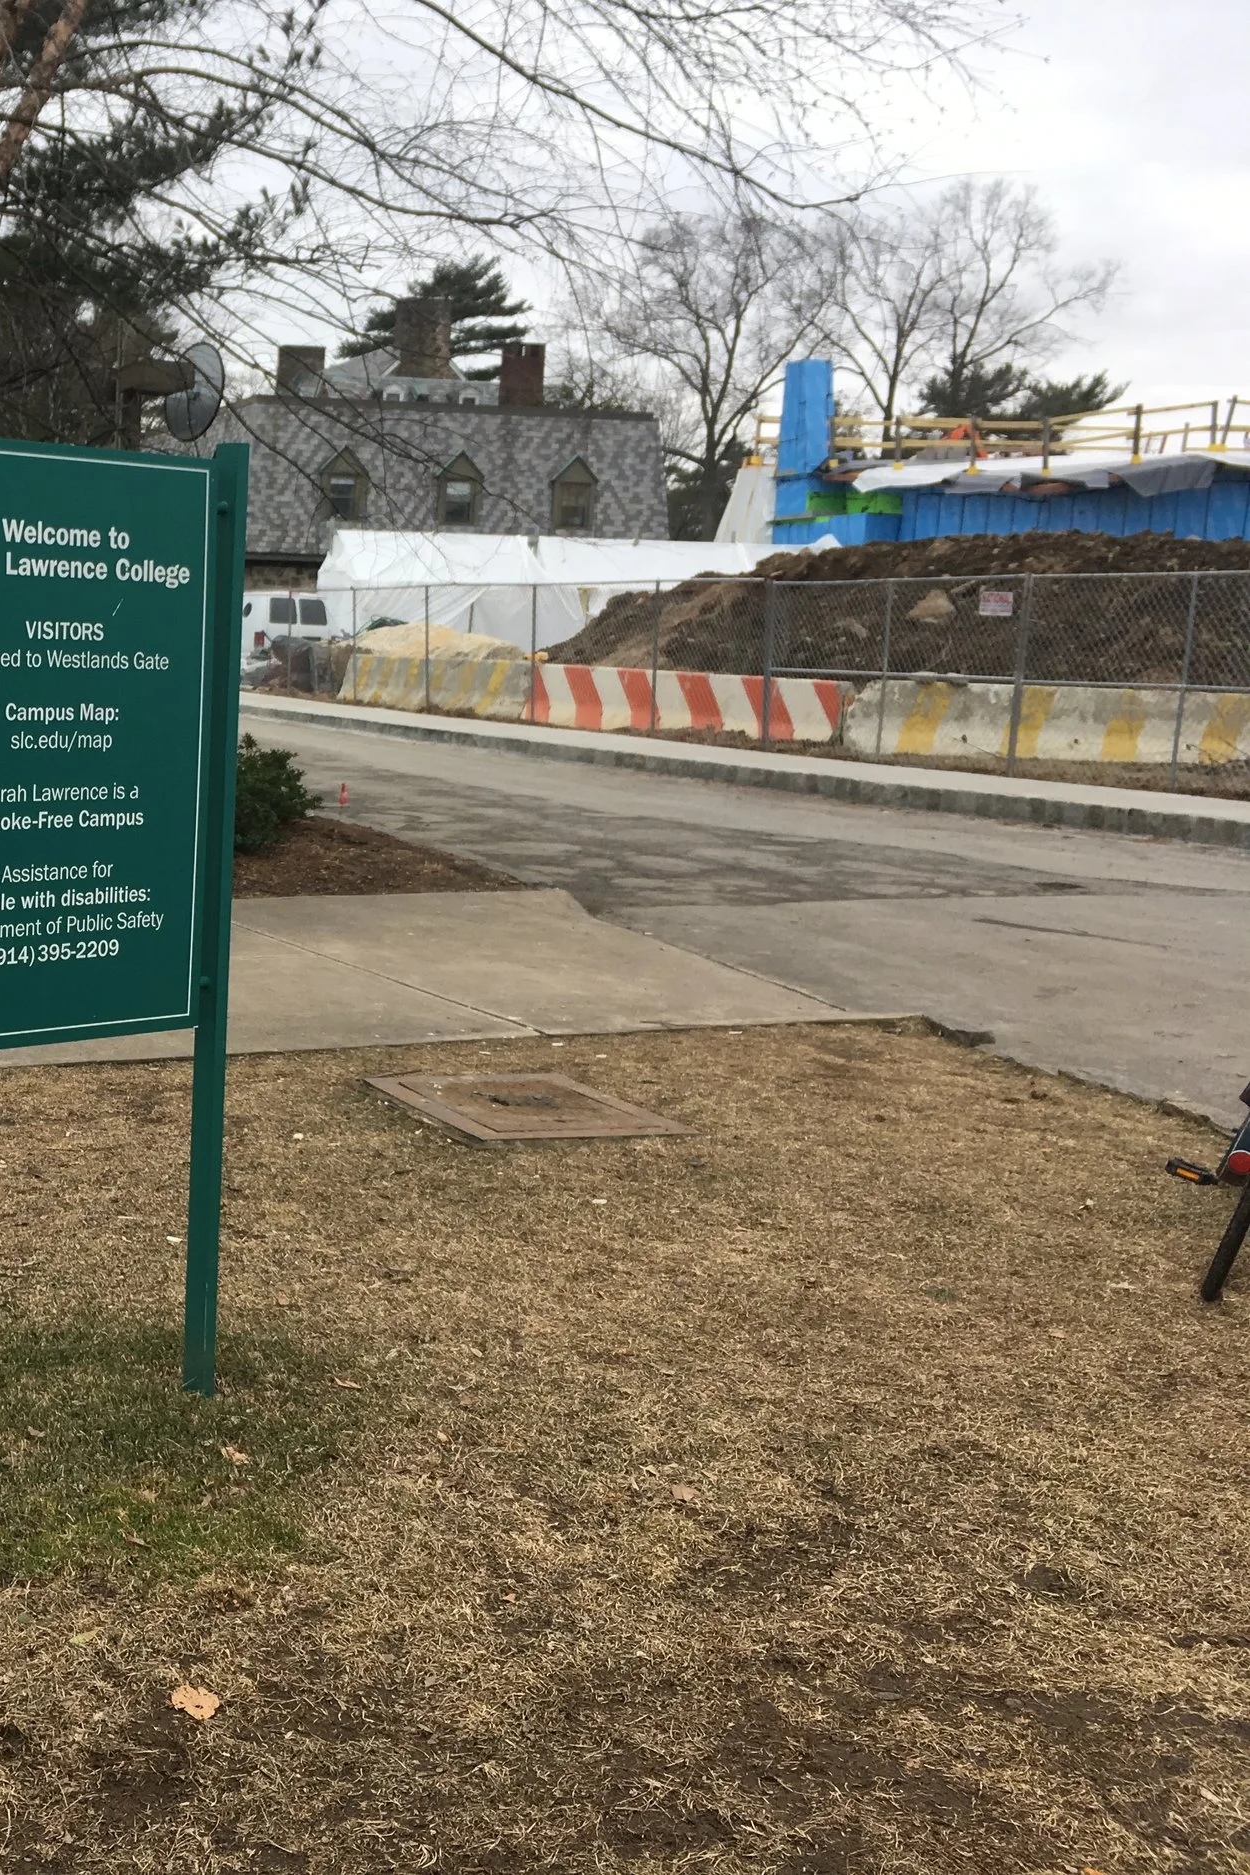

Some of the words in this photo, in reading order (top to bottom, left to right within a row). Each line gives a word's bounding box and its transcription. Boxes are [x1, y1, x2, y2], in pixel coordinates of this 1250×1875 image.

[1, 518, 101, 547] Welcome
[108, 526, 129, 549] to
[5, 551, 107, 579] Lawrence
[115, 557, 190, 588] College
[25, 620, 103, 641] VISITORS
[25, 650, 41, 667] to
[46, 649, 128, 669] Westlands
[133, 651, 168, 669] Gate
[5, 702, 74, 725] Campus
[79, 703, 118, 724] Map:
[10, 730, 112, 752] slc.edu/map
[32, 783, 108, 801] Lawrence
[113, 782, 125, 799] is
[129, 785, 138, 799] a
[78, 809, 143, 830] Campus
[1, 863, 87, 883] Assistance
[91, 860, 113, 877] for
[20, 890, 55, 909] with
[60, 885, 150, 906] disabilities:
[46, 916, 62, 934] of
[66, 913, 112, 932] Public
[116, 910, 163, 930] Safety
